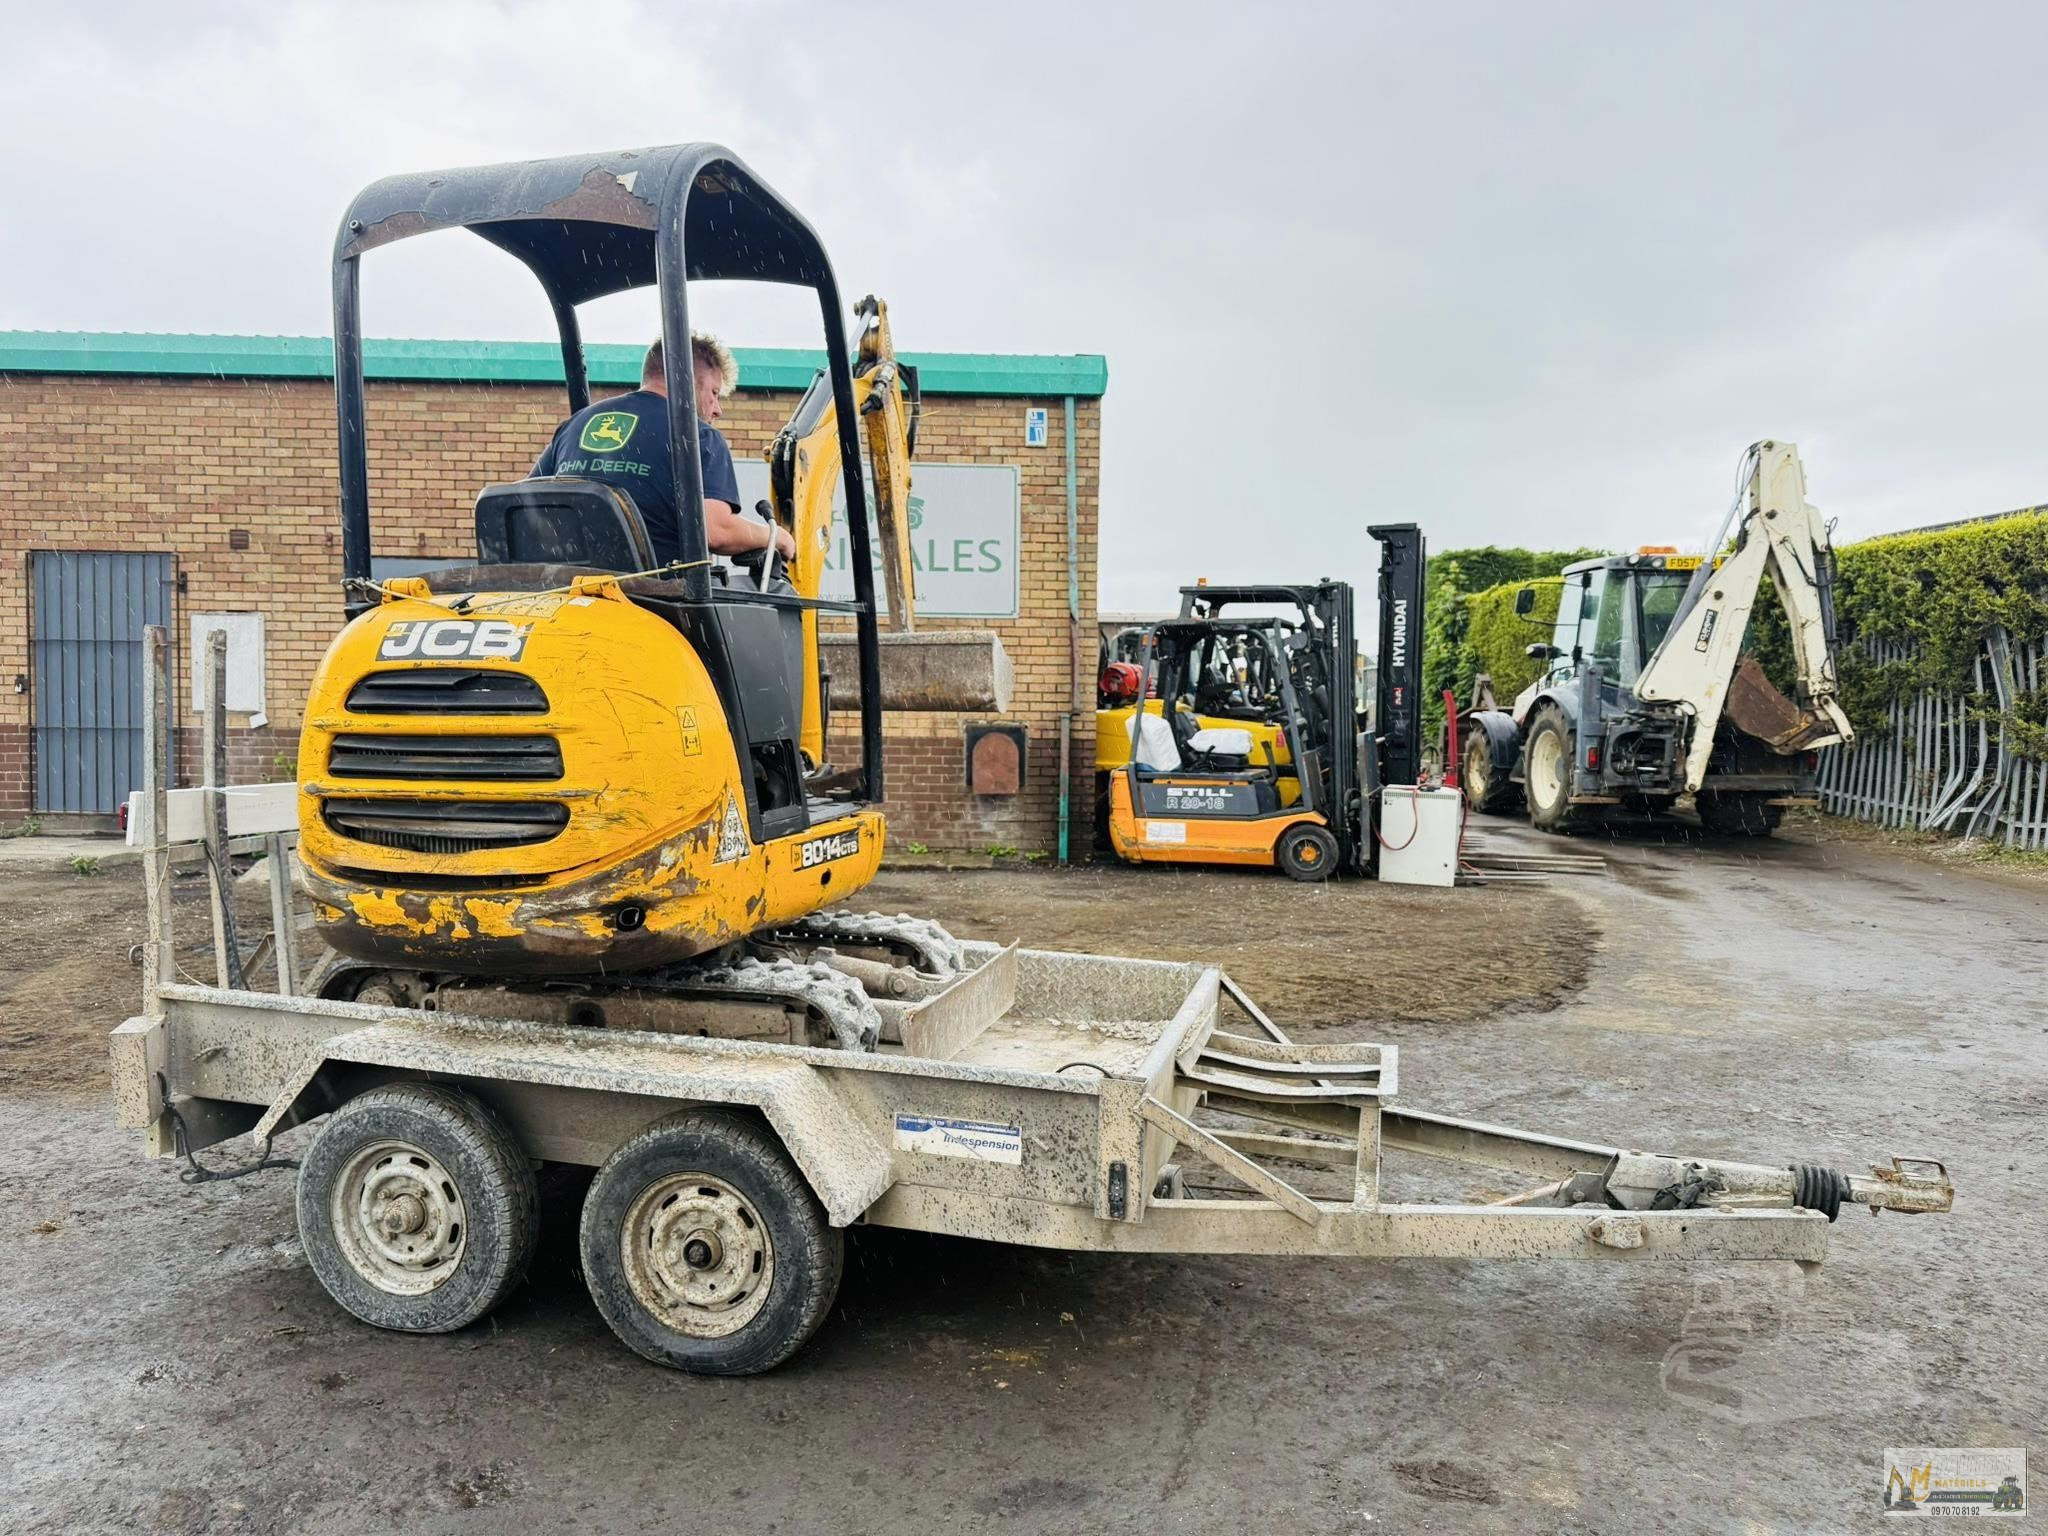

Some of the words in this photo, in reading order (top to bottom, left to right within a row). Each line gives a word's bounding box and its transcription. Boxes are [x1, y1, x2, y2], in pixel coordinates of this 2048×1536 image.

[558, 460, 588, 473] OHN
[590, 458, 651, 476] DEERE
[1669, 558, 1697, 568] FD57
[381, 620, 522, 657] JCB
[1392, 600, 1408, 667] HYUNDAI
[1167, 787, 1233, 796] STILL
[1167, 796, 1178, 809] R
[1181, 796, 1225, 810] 20-18
[943, 1133, 1020, 1152] Indespension
